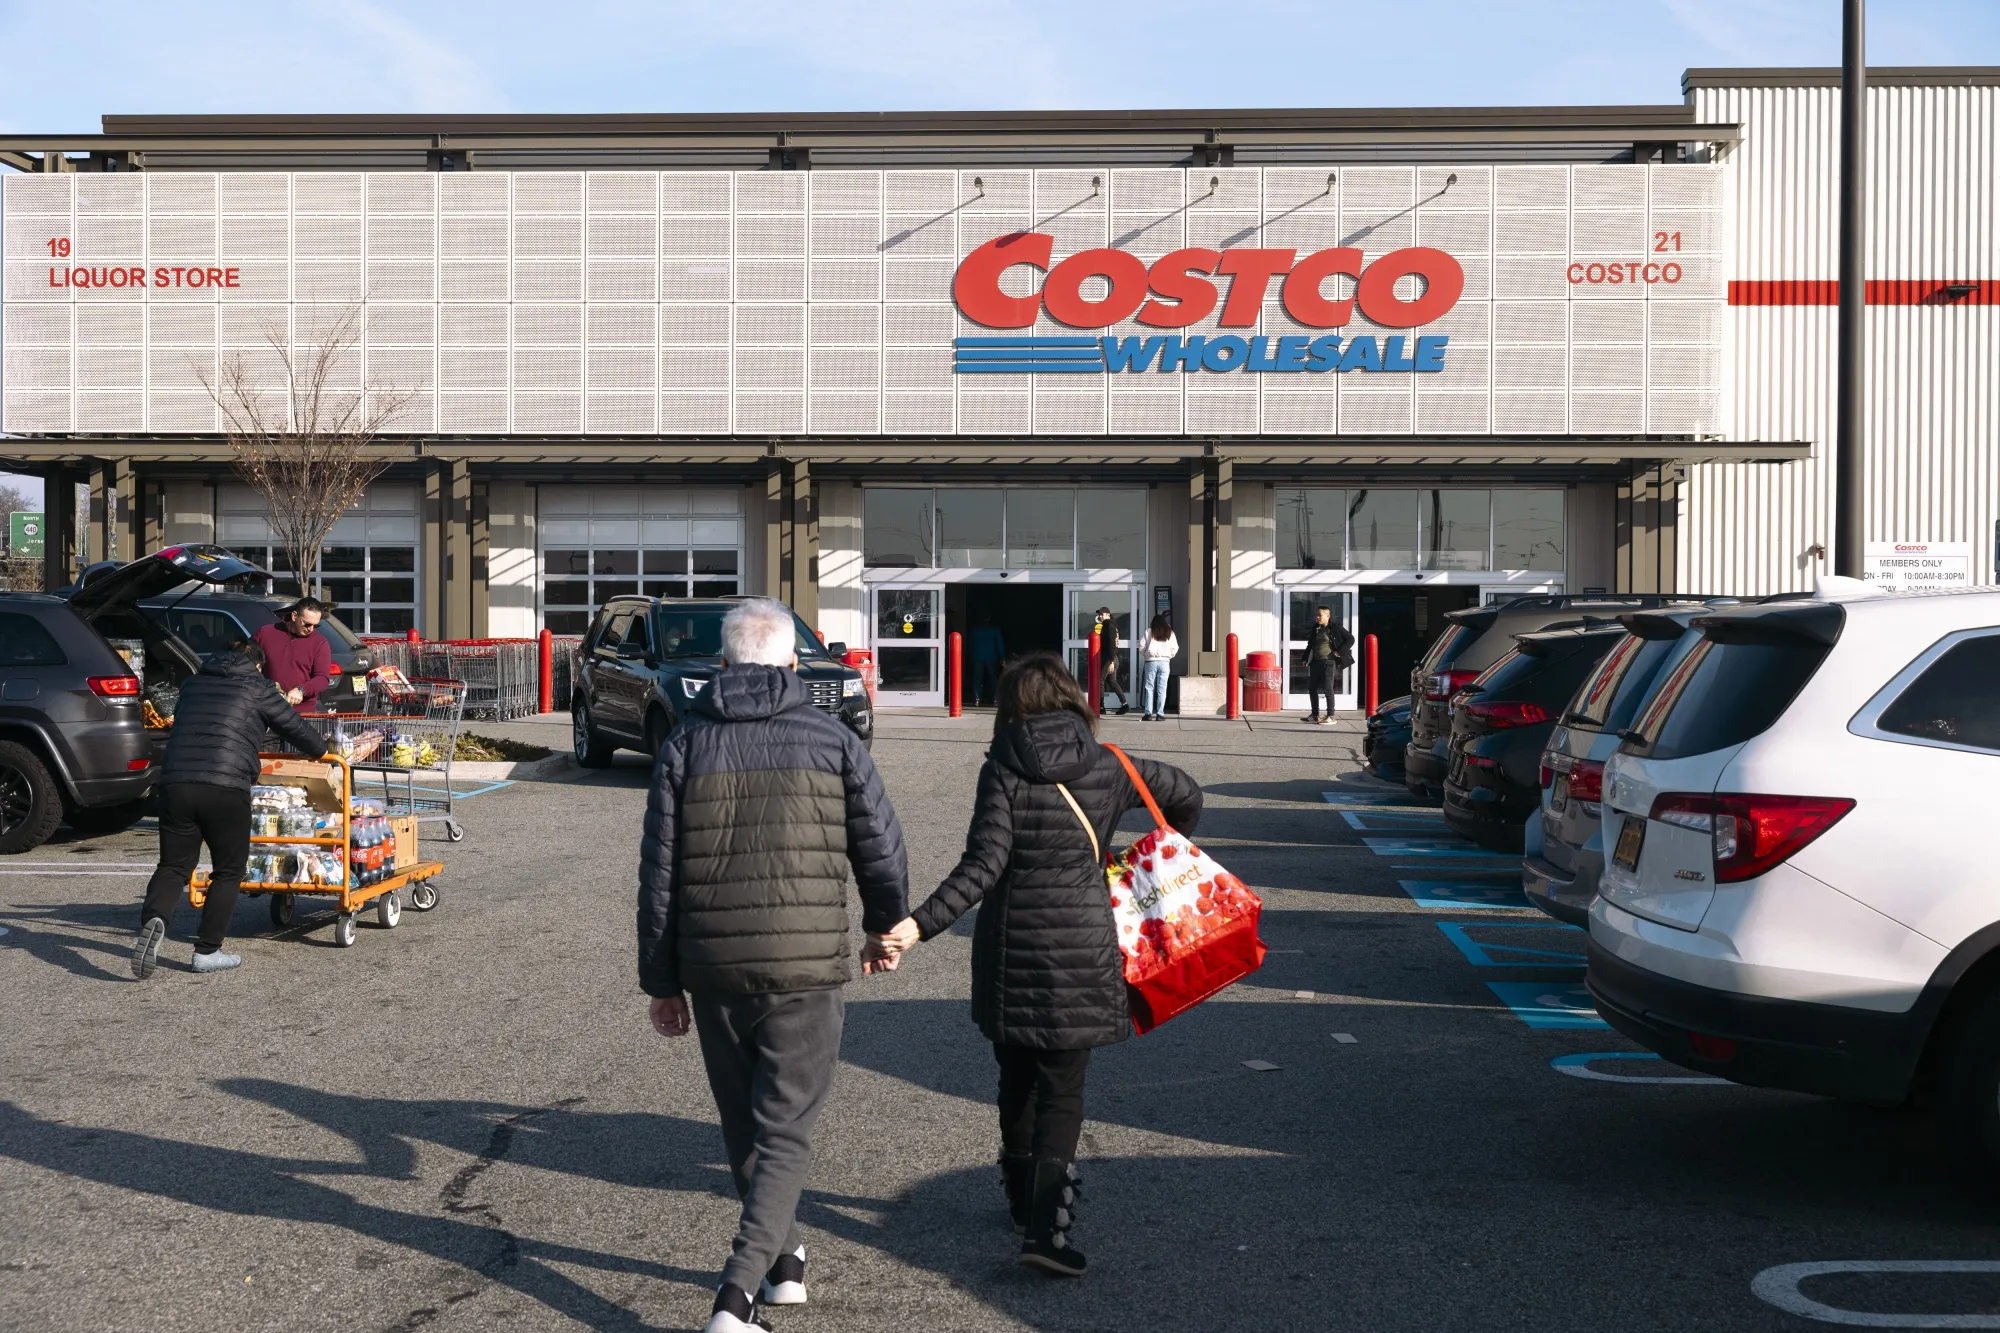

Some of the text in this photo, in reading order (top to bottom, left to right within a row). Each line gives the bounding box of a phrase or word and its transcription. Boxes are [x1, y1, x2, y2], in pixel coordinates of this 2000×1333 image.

[47, 237, 71, 258] 19
[1654, 231, 1682, 252] 21
[49, 267, 241, 289] LIQUOR STORE
[953, 231, 1465, 329] COSTCO
[1567, 262, 1682, 284] COSTCO
[1101, 335, 1450, 373] WHOLESALE
[1879, 559, 1943, 567] MEMBERS ONLY
[1864, 572, 1875, 580] ON
[1881, 572, 1894, 580] FRI
[1903, 572, 1965, 580] 10:00AM-8:30PM
[1130, 864, 1203, 914] freshdirect
